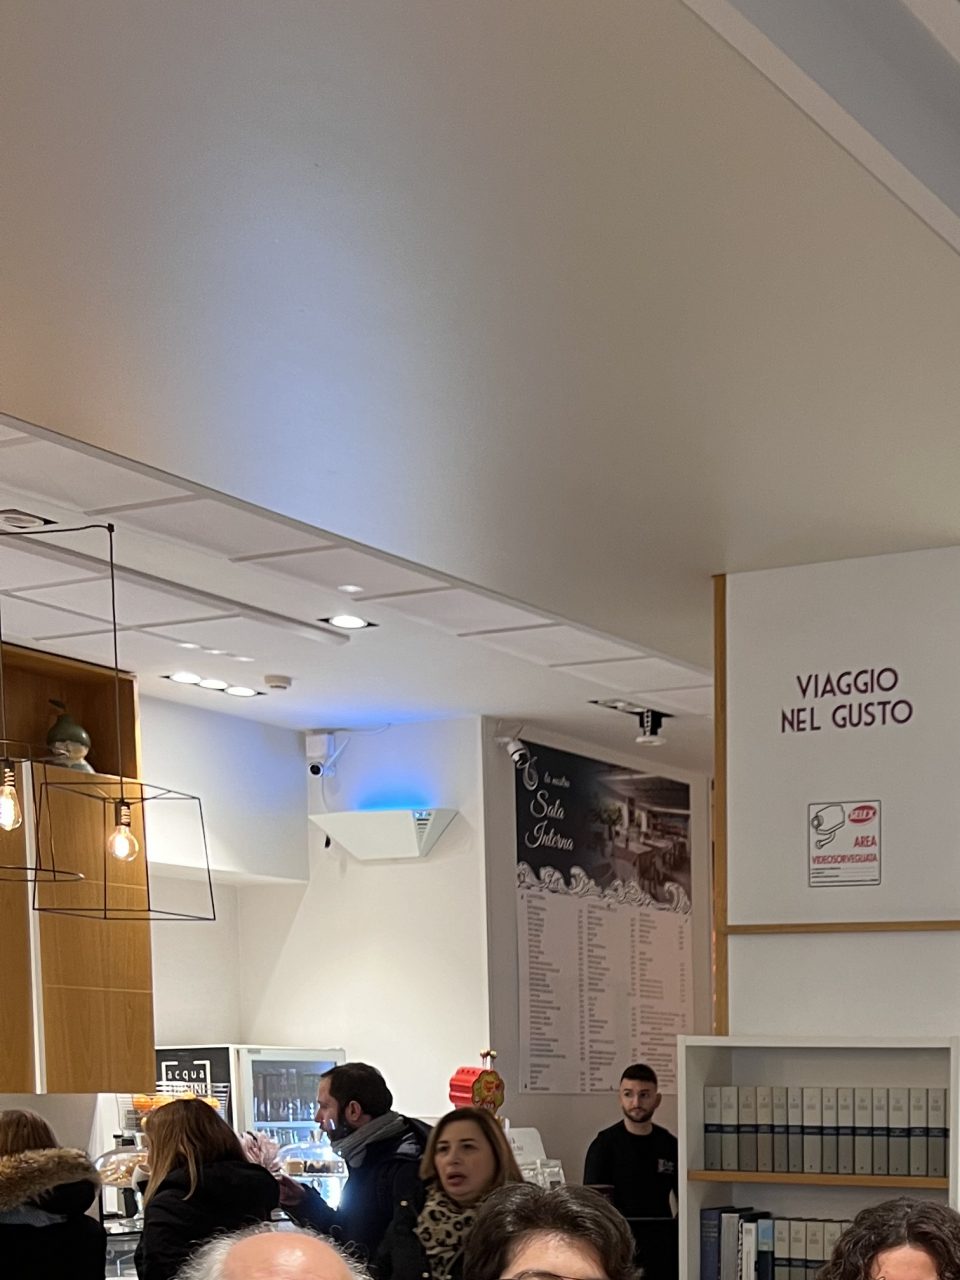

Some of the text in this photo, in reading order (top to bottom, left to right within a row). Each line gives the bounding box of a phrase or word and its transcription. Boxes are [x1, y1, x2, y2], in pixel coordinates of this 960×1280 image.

[796, 667, 899, 699] VIAGGIO
[781, 699, 913, 733] NEL GUSTO
[529, 789, 565, 820] Sala
[524, 820, 574, 851] Interna
[853, 835, 877, 848] AREA
[167, 1070, 205, 1081] acqua
